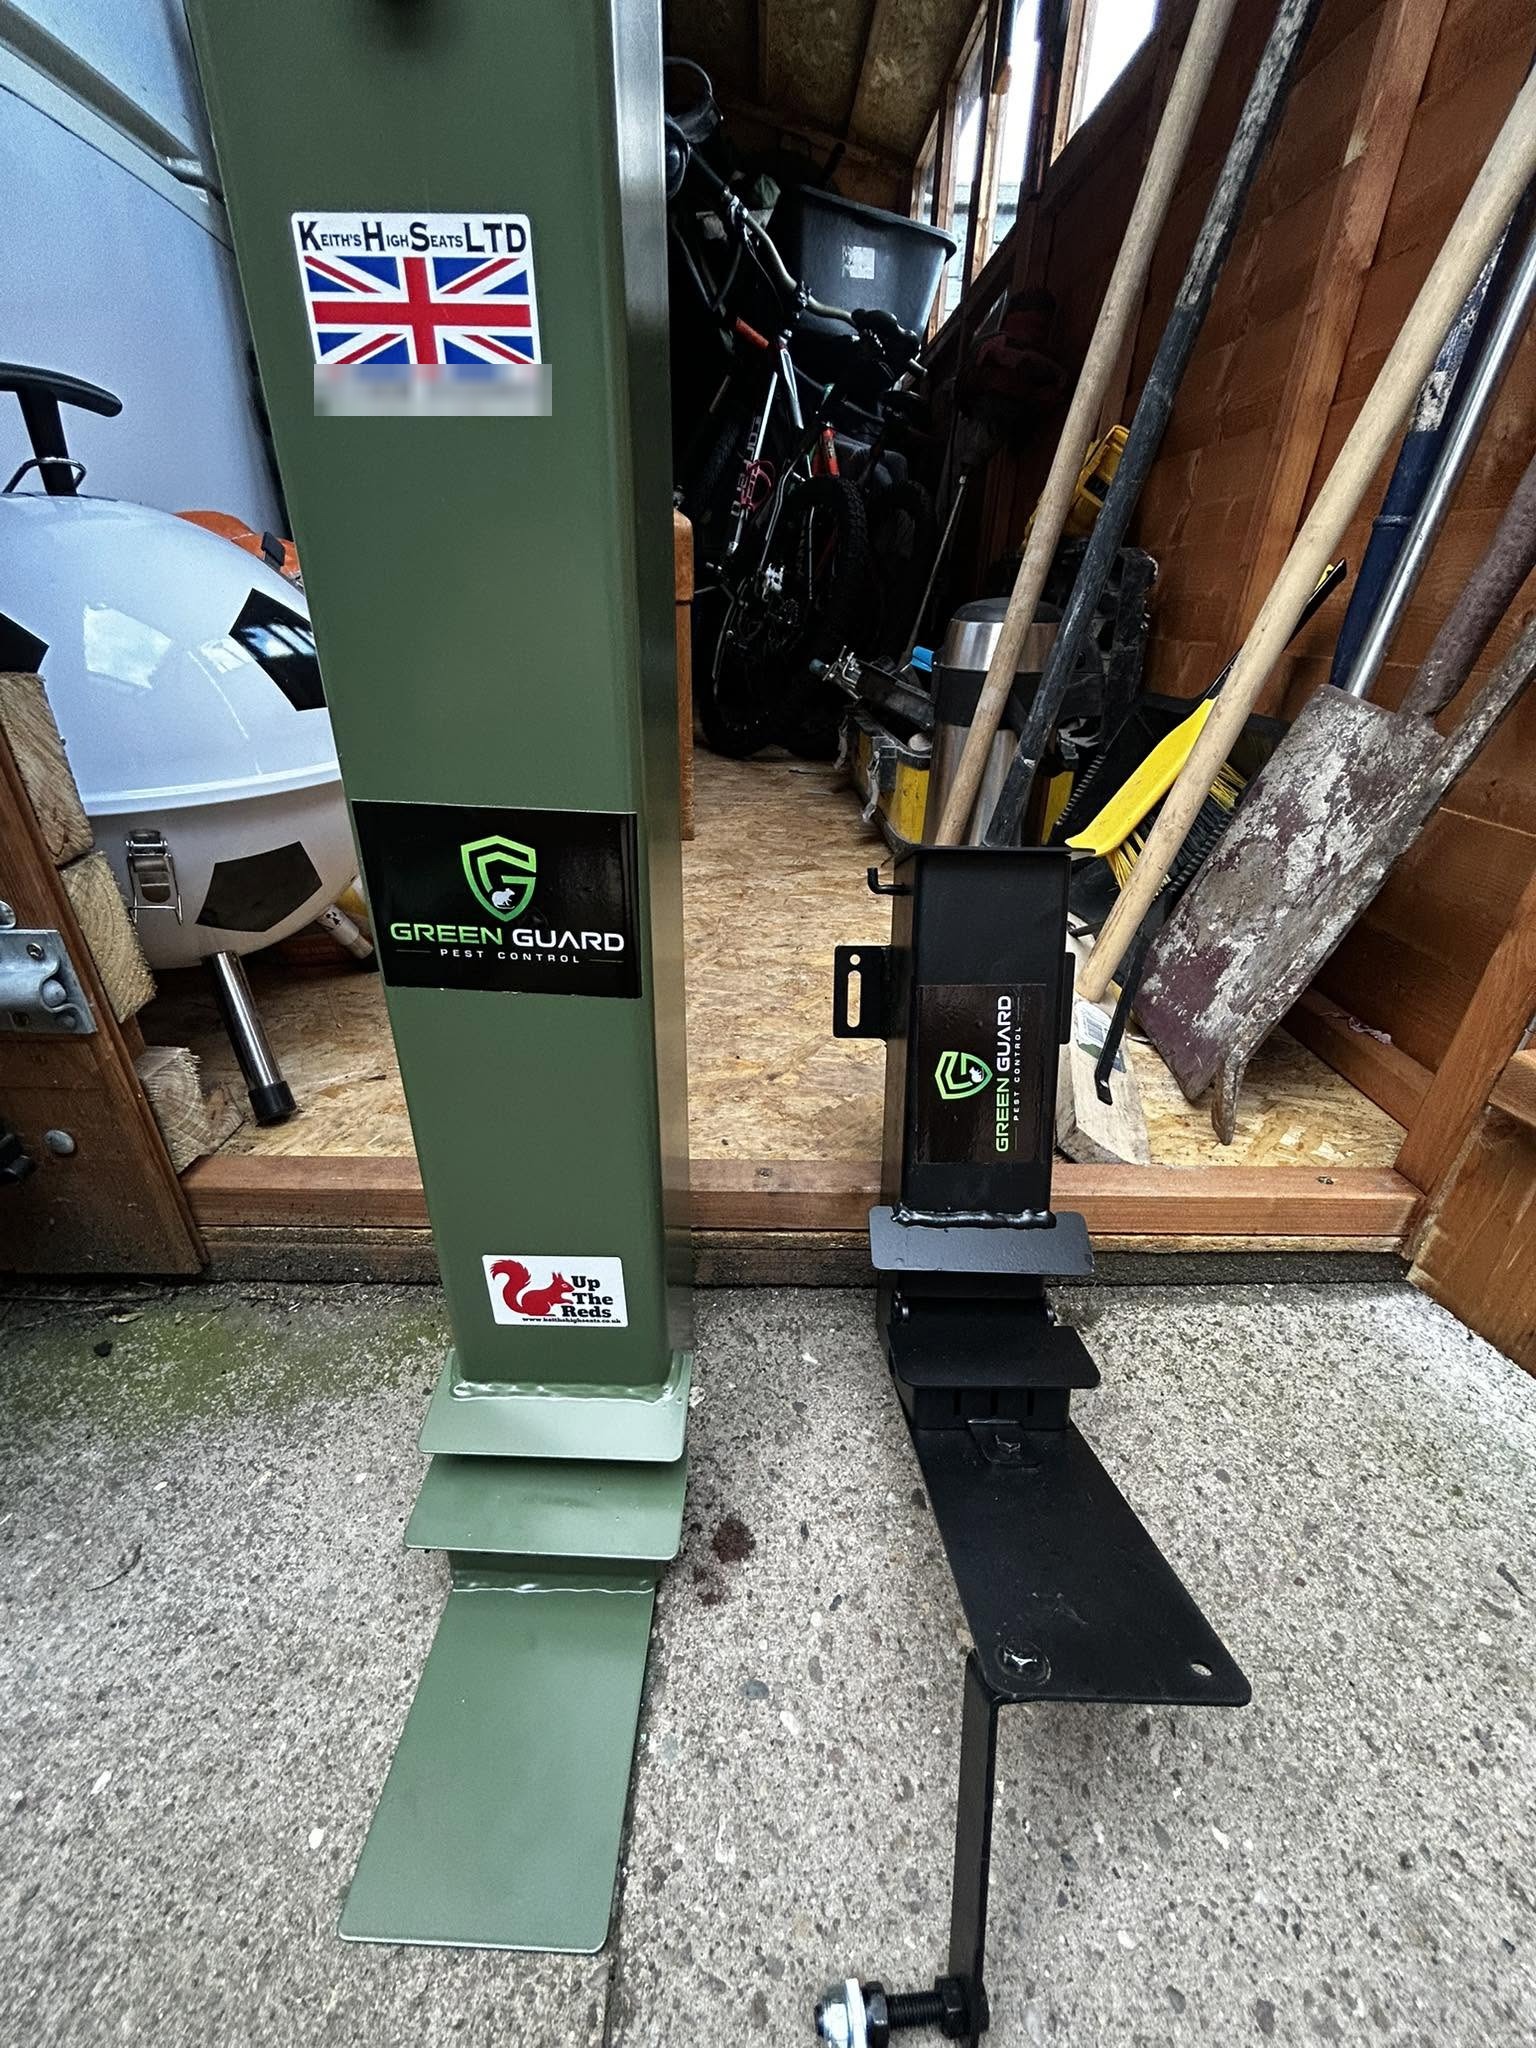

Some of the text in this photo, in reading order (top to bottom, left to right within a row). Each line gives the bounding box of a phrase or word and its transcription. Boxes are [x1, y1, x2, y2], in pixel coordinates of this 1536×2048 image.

[464, 222, 527, 253] LTD
[390, 922, 625, 951] GREEN GUARD
[440, 948, 580, 964] PEST CONTROL
[1014, 1027, 1022, 1083] CONTROL
[995, 995, 1012, 1152] GREEN GUARD
[571, 1275, 600, 1291] Up
[572, 1292, 613, 1305] The
[561, 1305, 612, 1318] Reds
